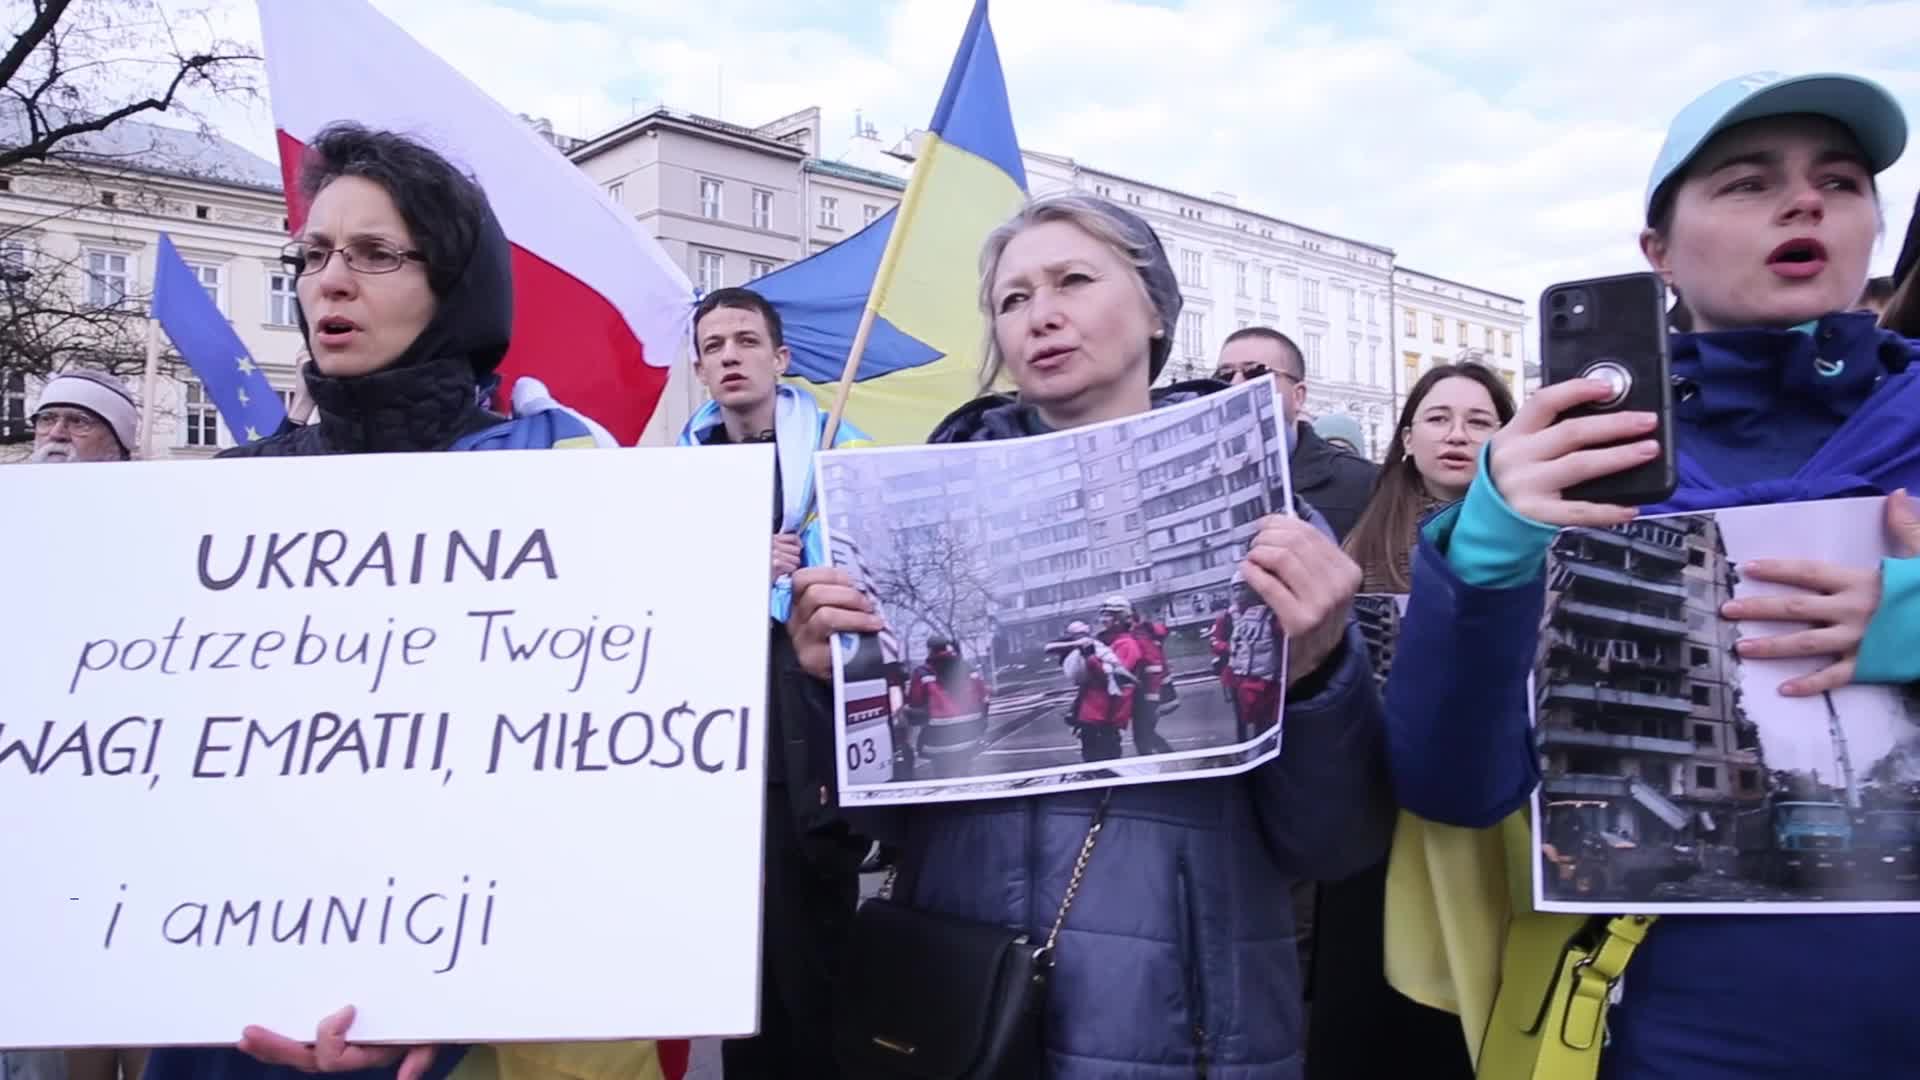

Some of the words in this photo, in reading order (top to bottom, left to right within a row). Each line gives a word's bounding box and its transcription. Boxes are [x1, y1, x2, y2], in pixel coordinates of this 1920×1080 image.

[197, 527, 559, 592] UKRAINA
[68, 613, 437, 695] potrzebuje
[466, 609, 653, 695] Twojej
[191, 711, 453, 786] EMPATII,
[485, 700, 751, 775] MIŁOŚCI
[846, 738, 877, 771] 03
[103, 883, 127, 950] i
[162, 874, 498, 975] amunicji
